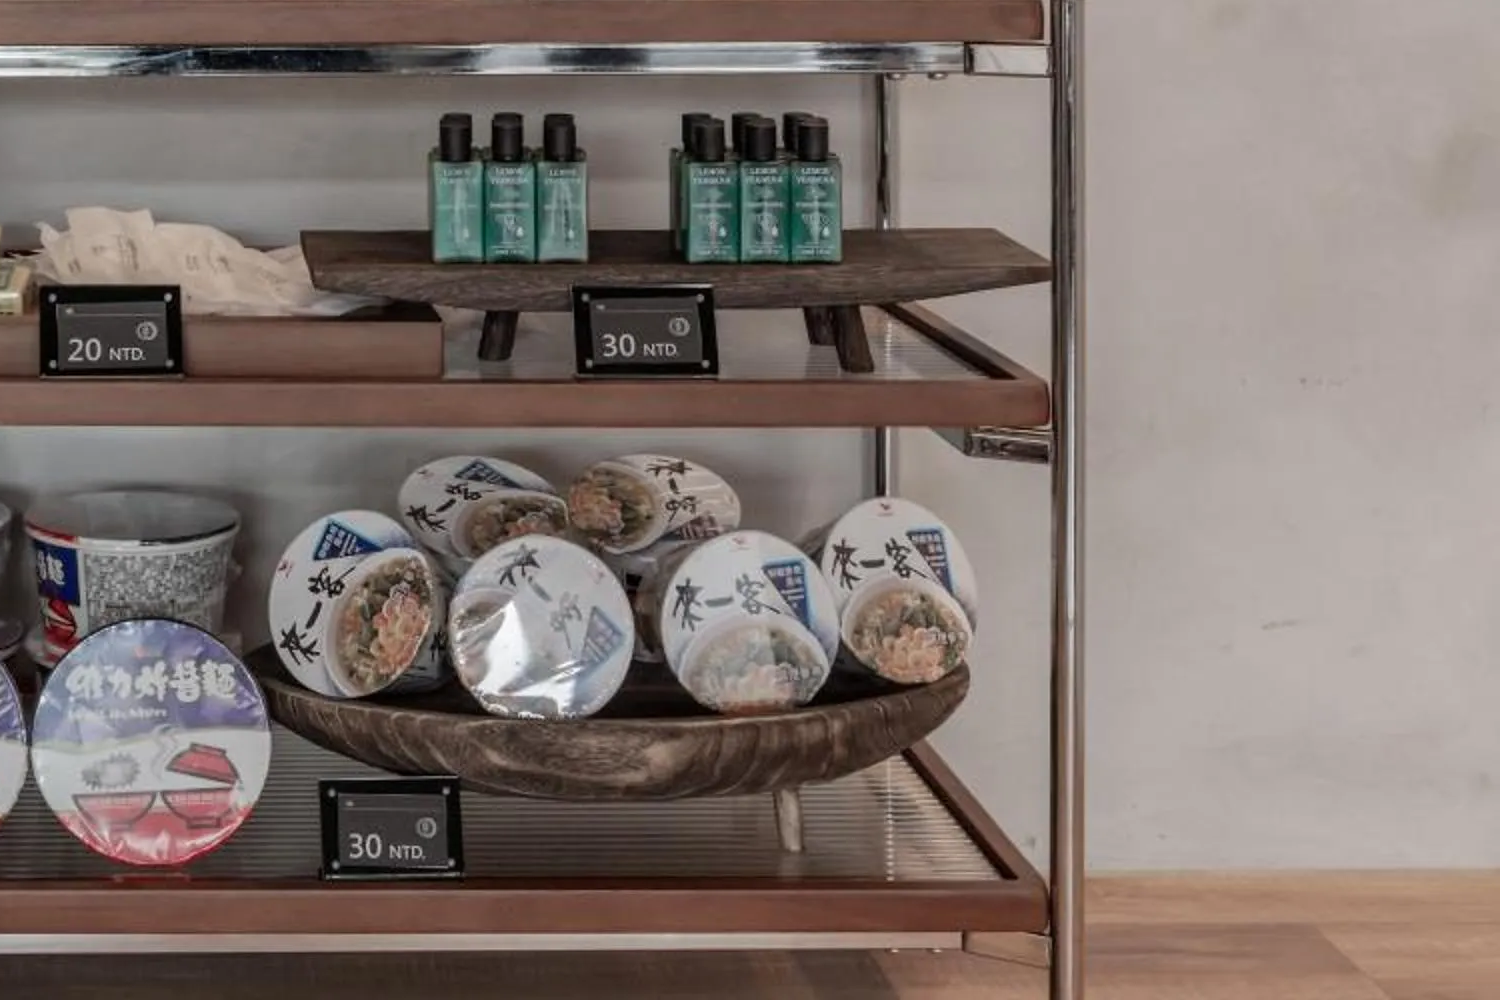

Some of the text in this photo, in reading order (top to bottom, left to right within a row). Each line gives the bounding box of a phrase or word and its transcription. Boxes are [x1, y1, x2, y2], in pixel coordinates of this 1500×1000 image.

[68, 339, 101, 362] 20
[602, 334, 635, 358] 30
[831, 538, 929, 590] 來一客
[673, 573, 781, 632] 來一客
[349, 833, 382, 859] 30
